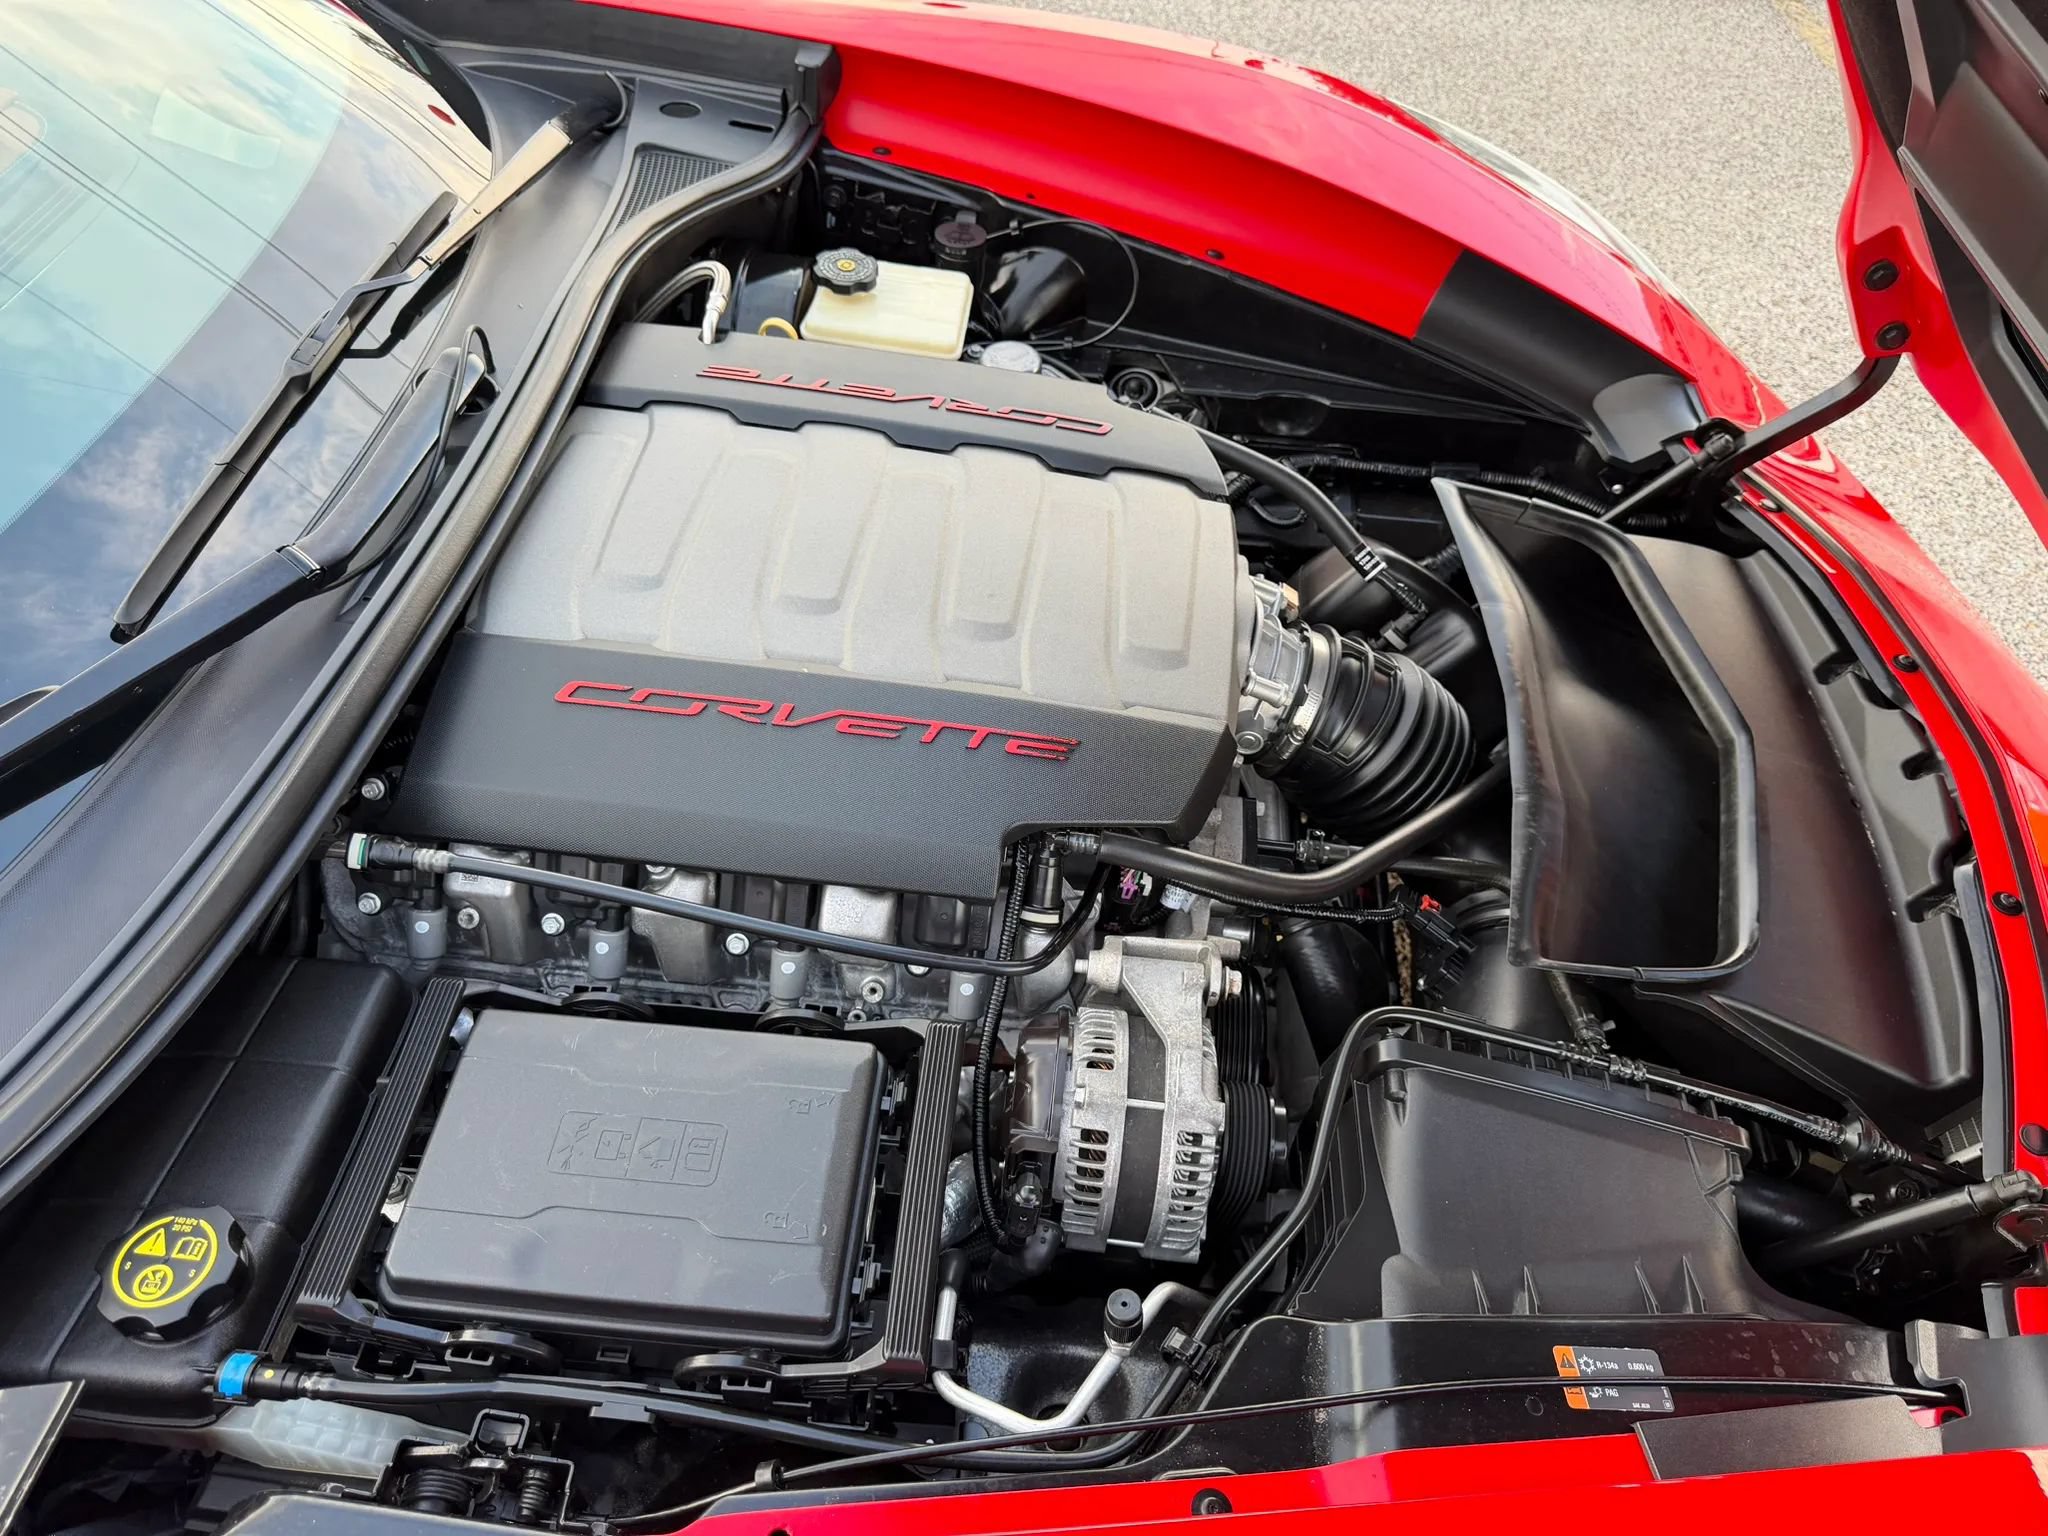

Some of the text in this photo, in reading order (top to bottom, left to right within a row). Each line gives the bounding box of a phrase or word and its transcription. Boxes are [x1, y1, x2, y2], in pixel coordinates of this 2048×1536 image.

[696, 365, 1113, 435] CORVETTE
[554, 681, 1081, 761] CORVETTE
[1596, 1361, 1619, 1370] R-134a
[1605, 1388, 1619, 1397] PAG
